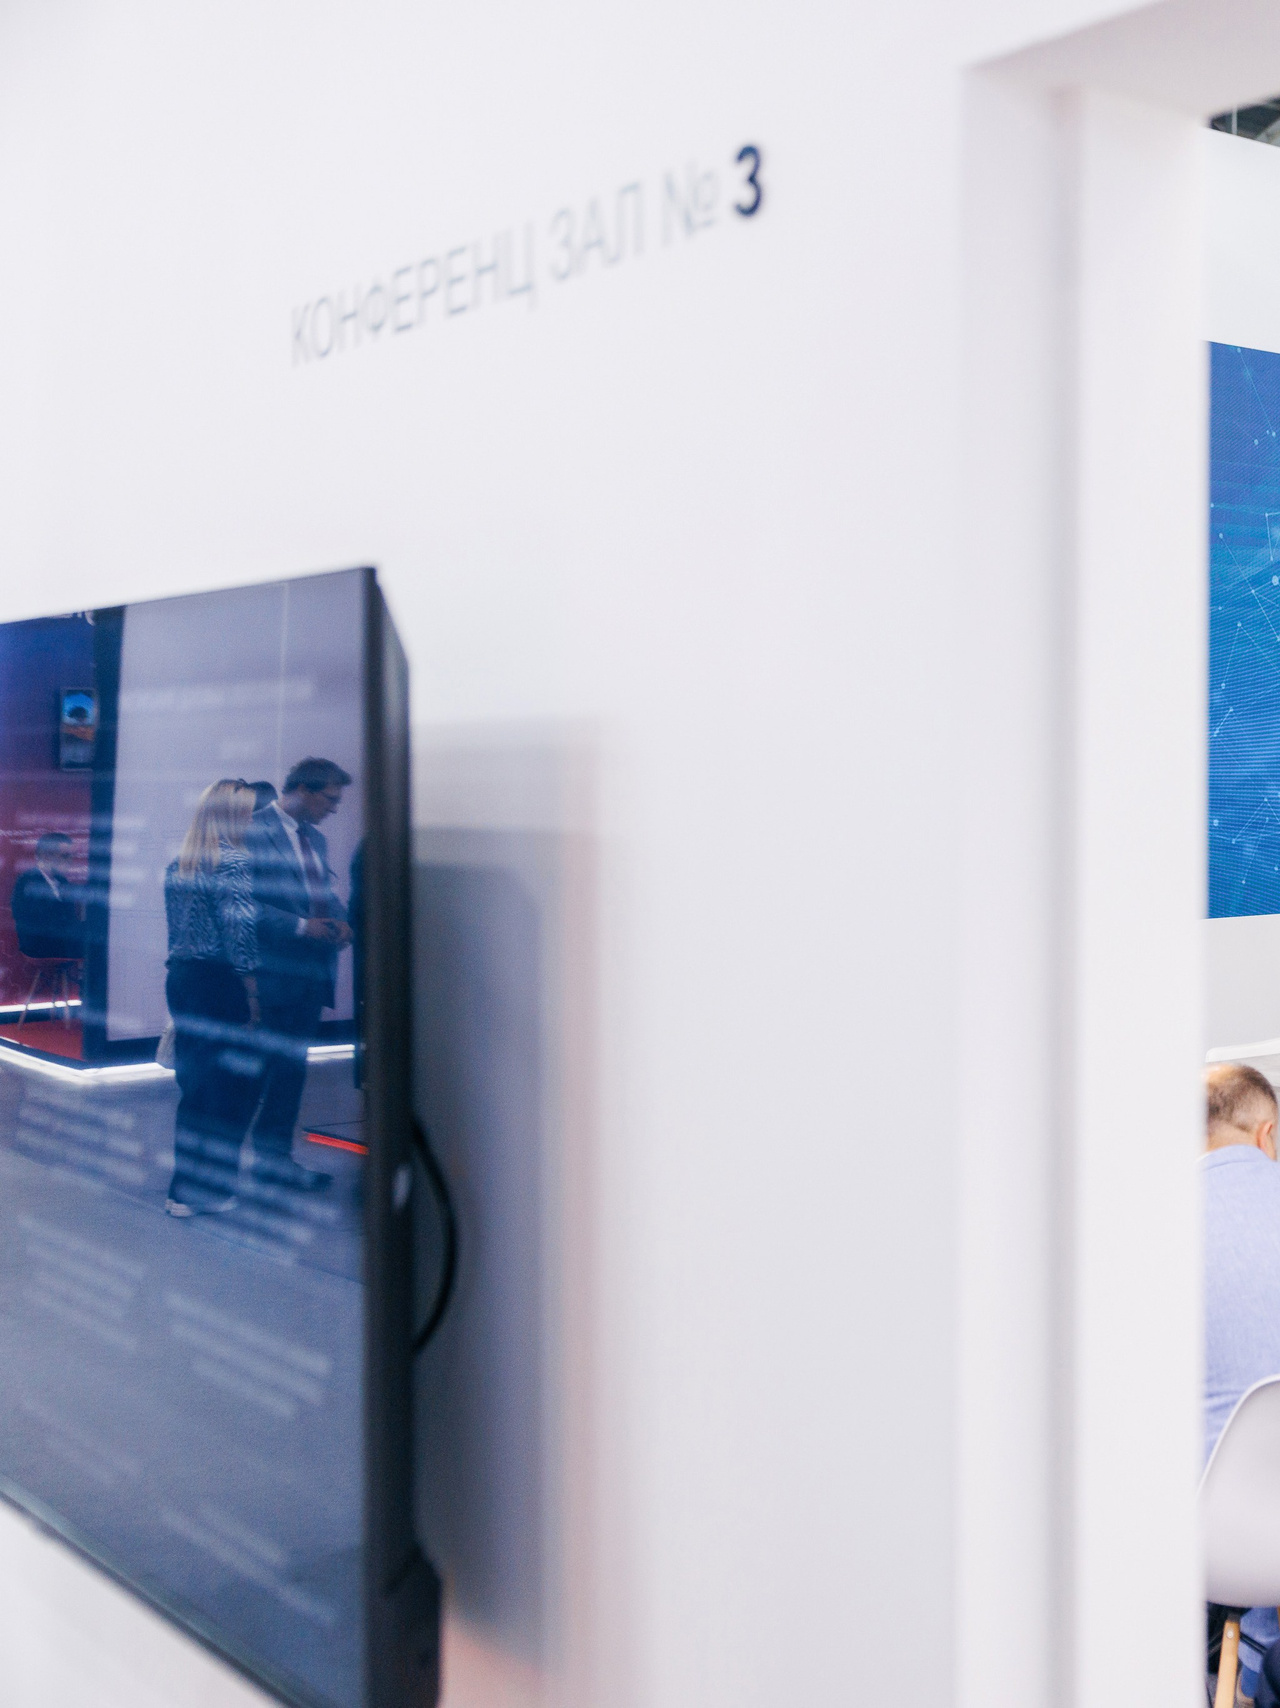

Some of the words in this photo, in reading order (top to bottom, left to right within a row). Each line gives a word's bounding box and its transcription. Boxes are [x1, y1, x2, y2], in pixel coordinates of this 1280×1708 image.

[290, 219, 537, 368] КОНФЕРЕНЦ
[548, 179, 646, 283] ЗАЛ
[660, 159, 719, 248] №
[733, 142, 766, 219] 3
